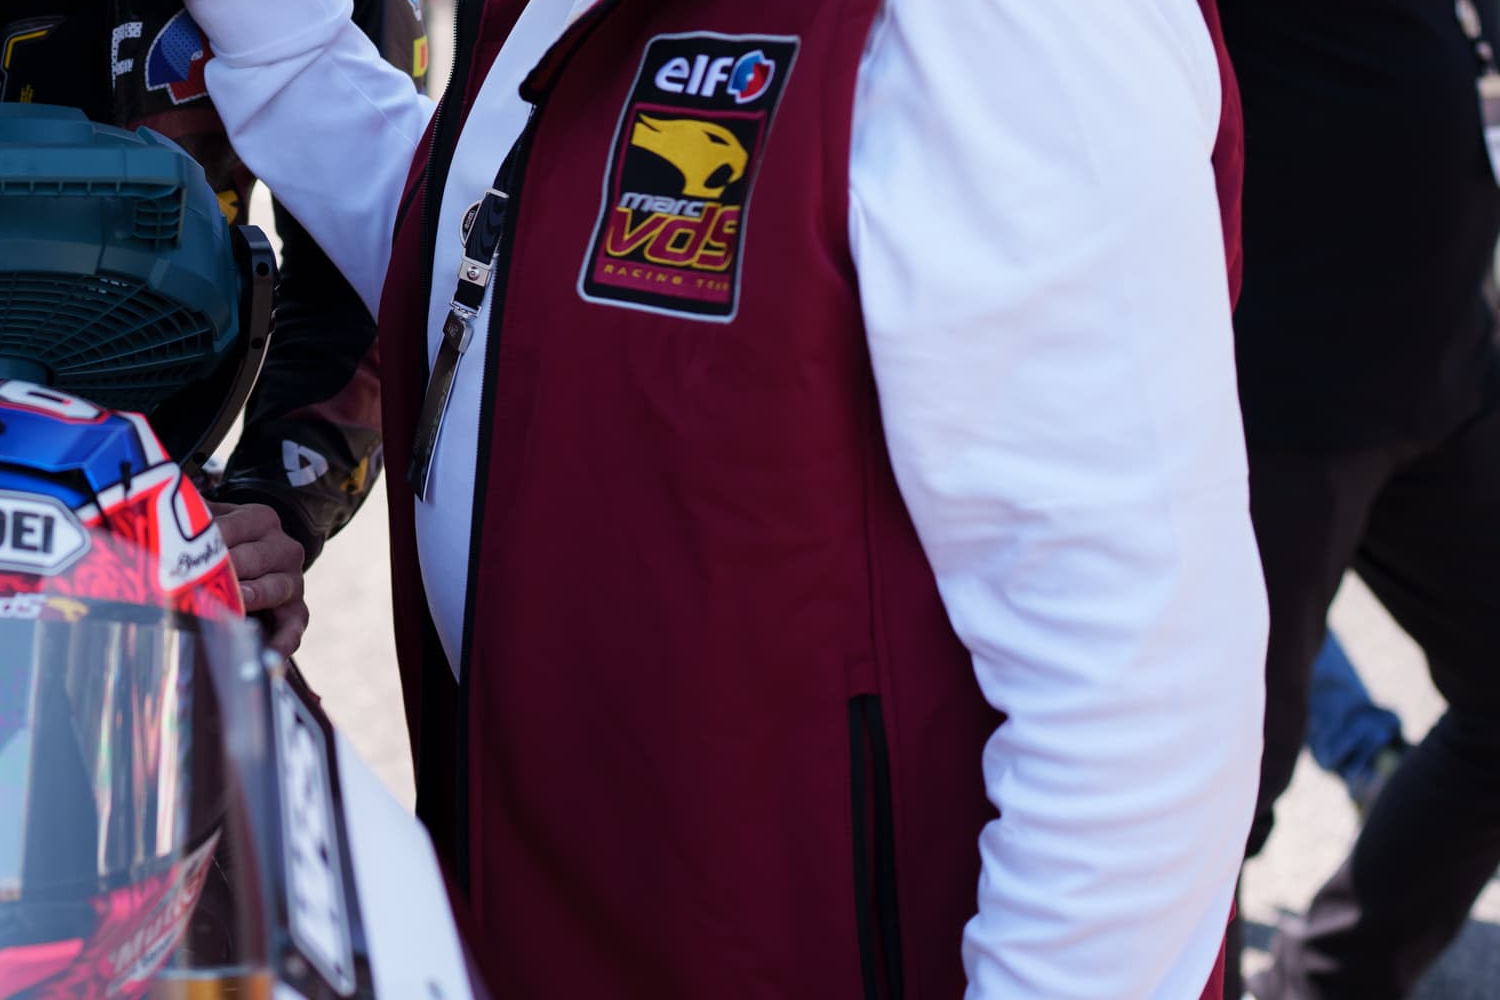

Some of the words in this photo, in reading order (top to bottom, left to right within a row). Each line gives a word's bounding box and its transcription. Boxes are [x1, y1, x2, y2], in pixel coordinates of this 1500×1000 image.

[654, 55, 734, 97] elf
[619, 192, 706, 218] marc
[603, 264, 683, 286] RACING
